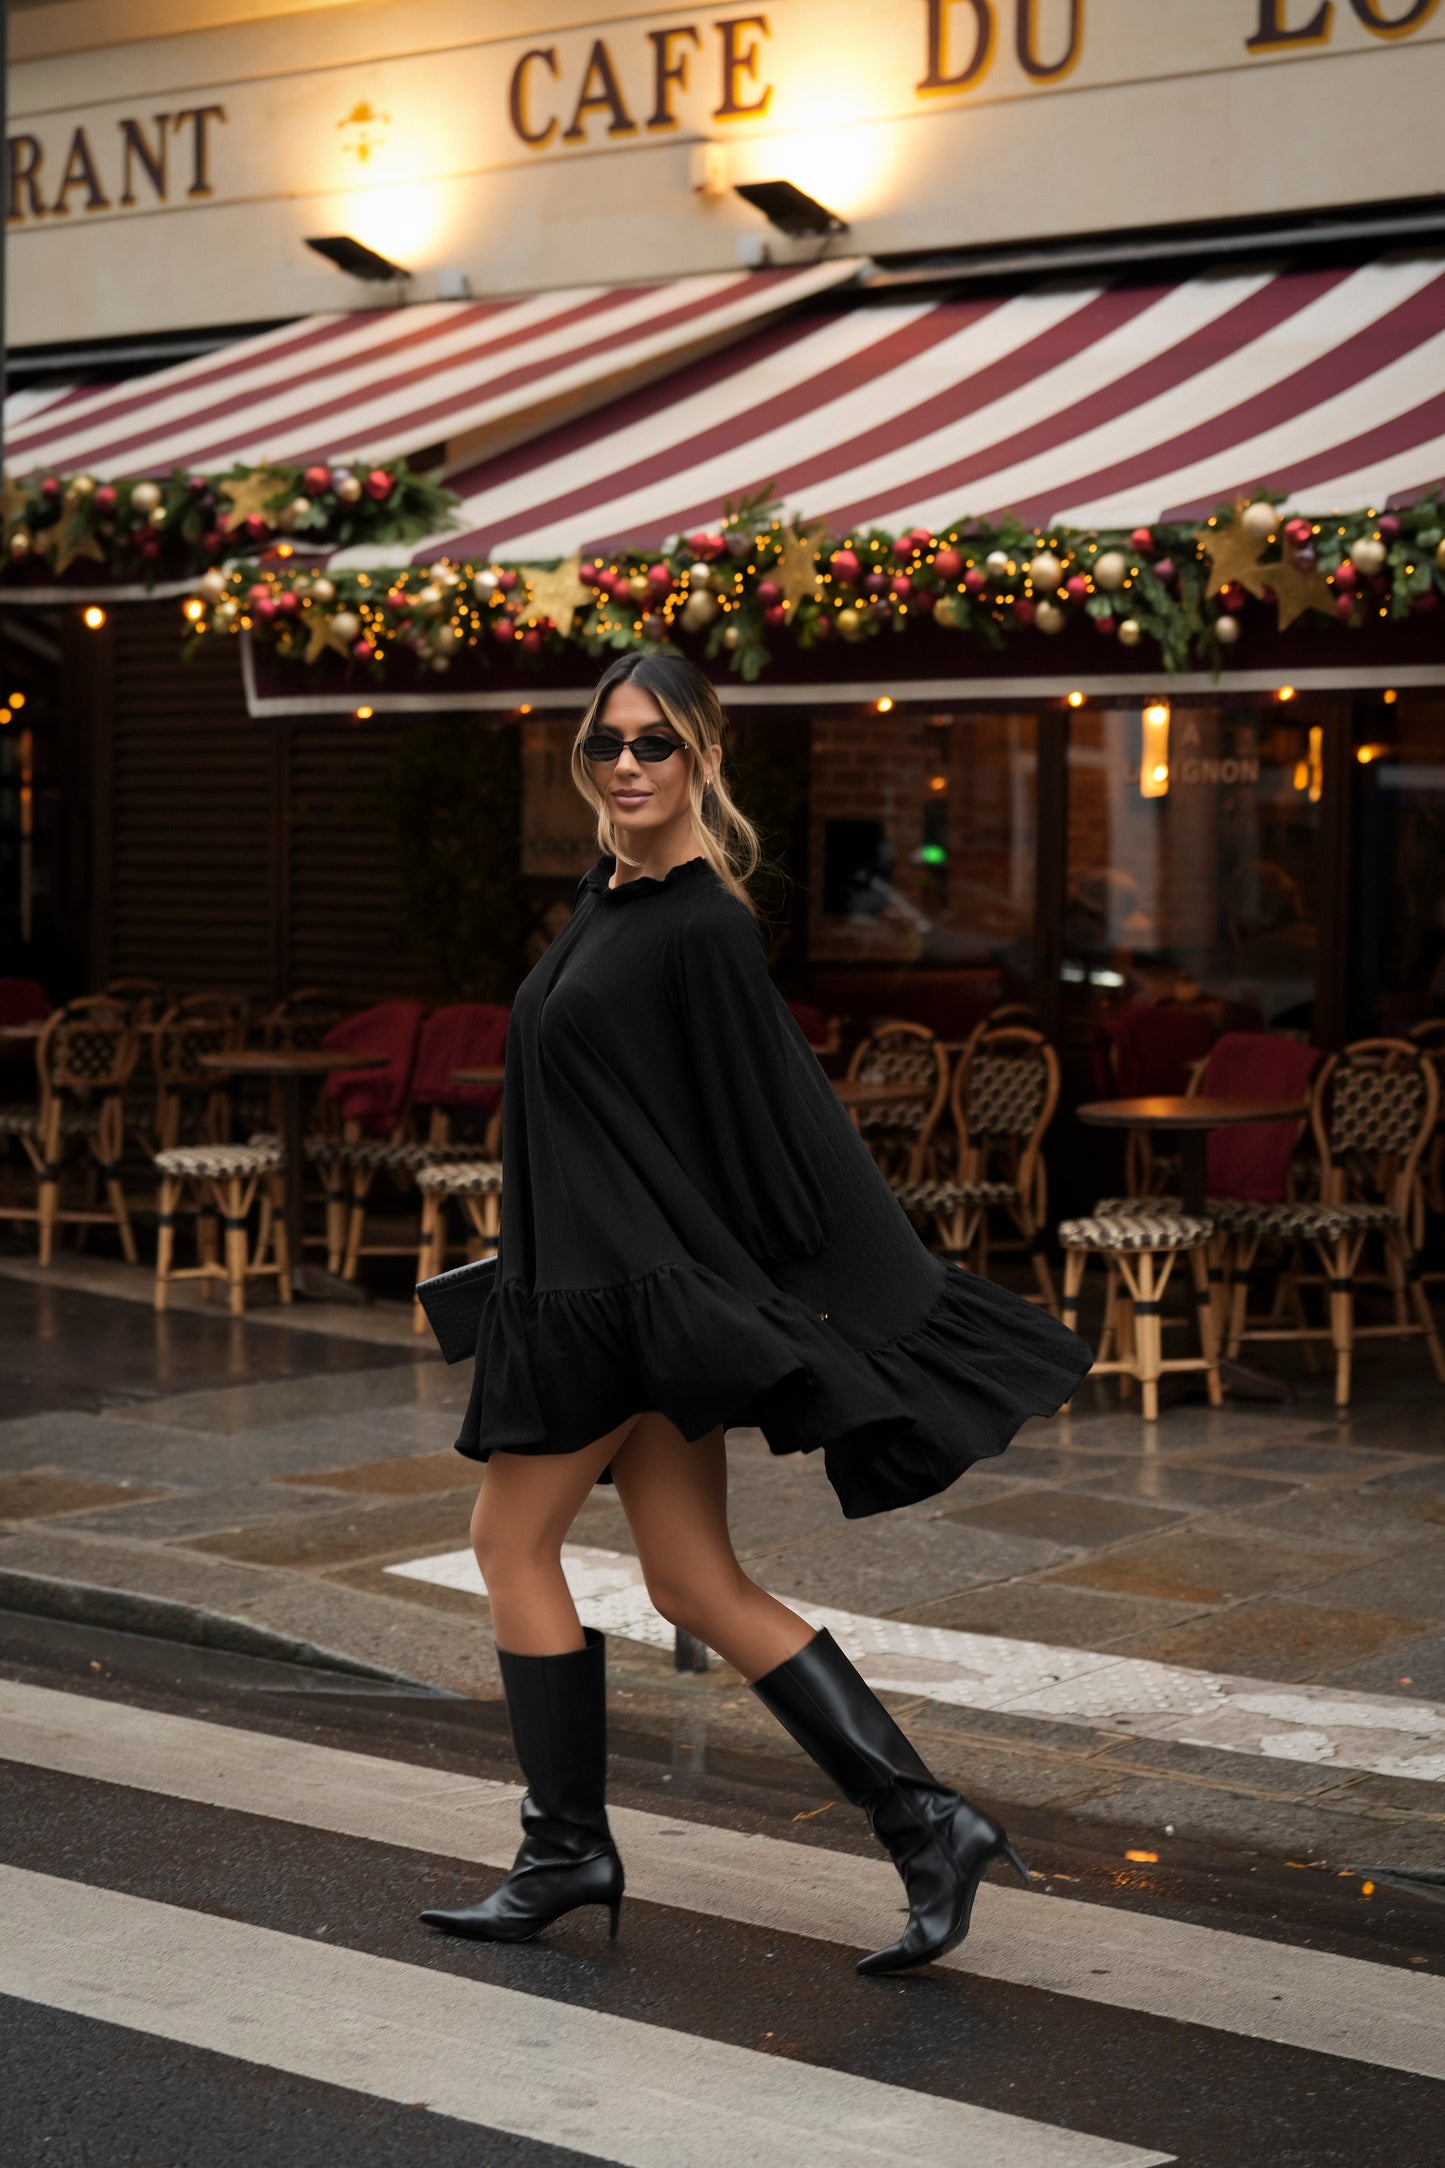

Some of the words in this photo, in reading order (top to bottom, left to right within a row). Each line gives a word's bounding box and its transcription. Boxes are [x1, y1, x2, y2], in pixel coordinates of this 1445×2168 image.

[8, 104, 226, 223] RANT
[509, 15, 773, 151] CAFE
[915, 0, 1084, 98] DU
